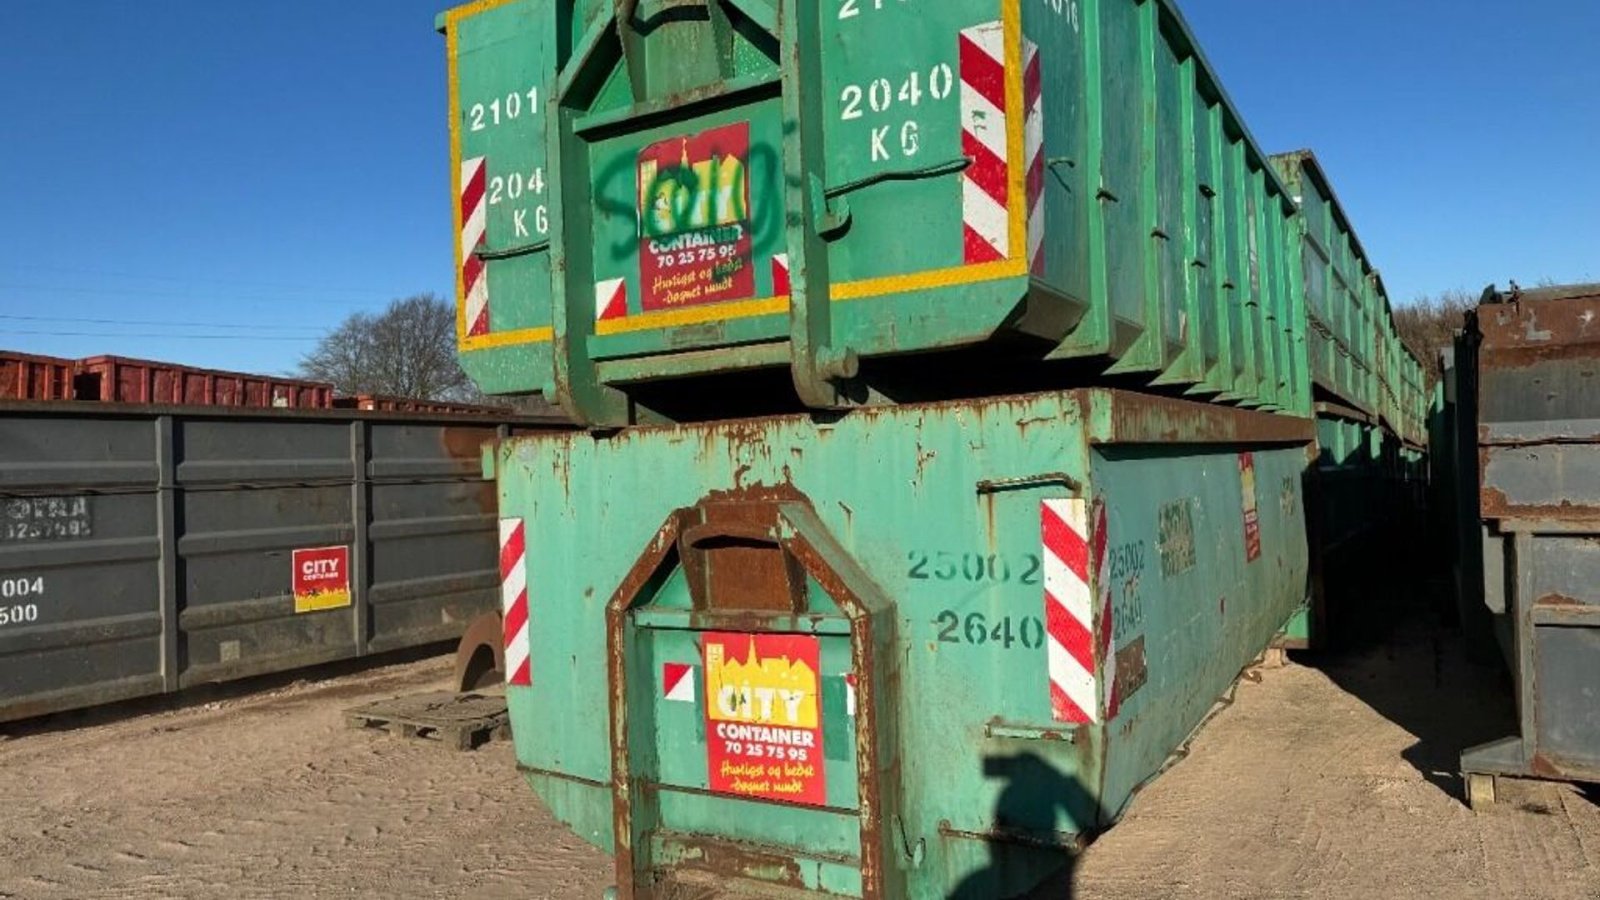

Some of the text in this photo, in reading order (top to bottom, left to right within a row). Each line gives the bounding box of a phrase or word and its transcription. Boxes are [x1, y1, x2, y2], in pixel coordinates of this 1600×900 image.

[841, 63, 953, 120] 2040
[470, 86, 537, 131] 2101
[871, 120, 919, 162] KG
[489, 167, 545, 205] 204
[514, 204, 548, 235] KG
[657, 244, 737, 268] 70 25 75 95
[699, 268, 713, 281] og
[302, 557, 340, 576] CITY
[907, 550, 1040, 585] 25002
[2, 576, 44, 597] 004
[0, 604, 38, 624] 500
[937, 609, 1045, 650] 2640
[716, 683, 807, 724] CITY
[716, 722, 816, 748] CONTAINER
[725, 740, 807, 761] 70 25 75 95
[767, 765, 781, 779] og
